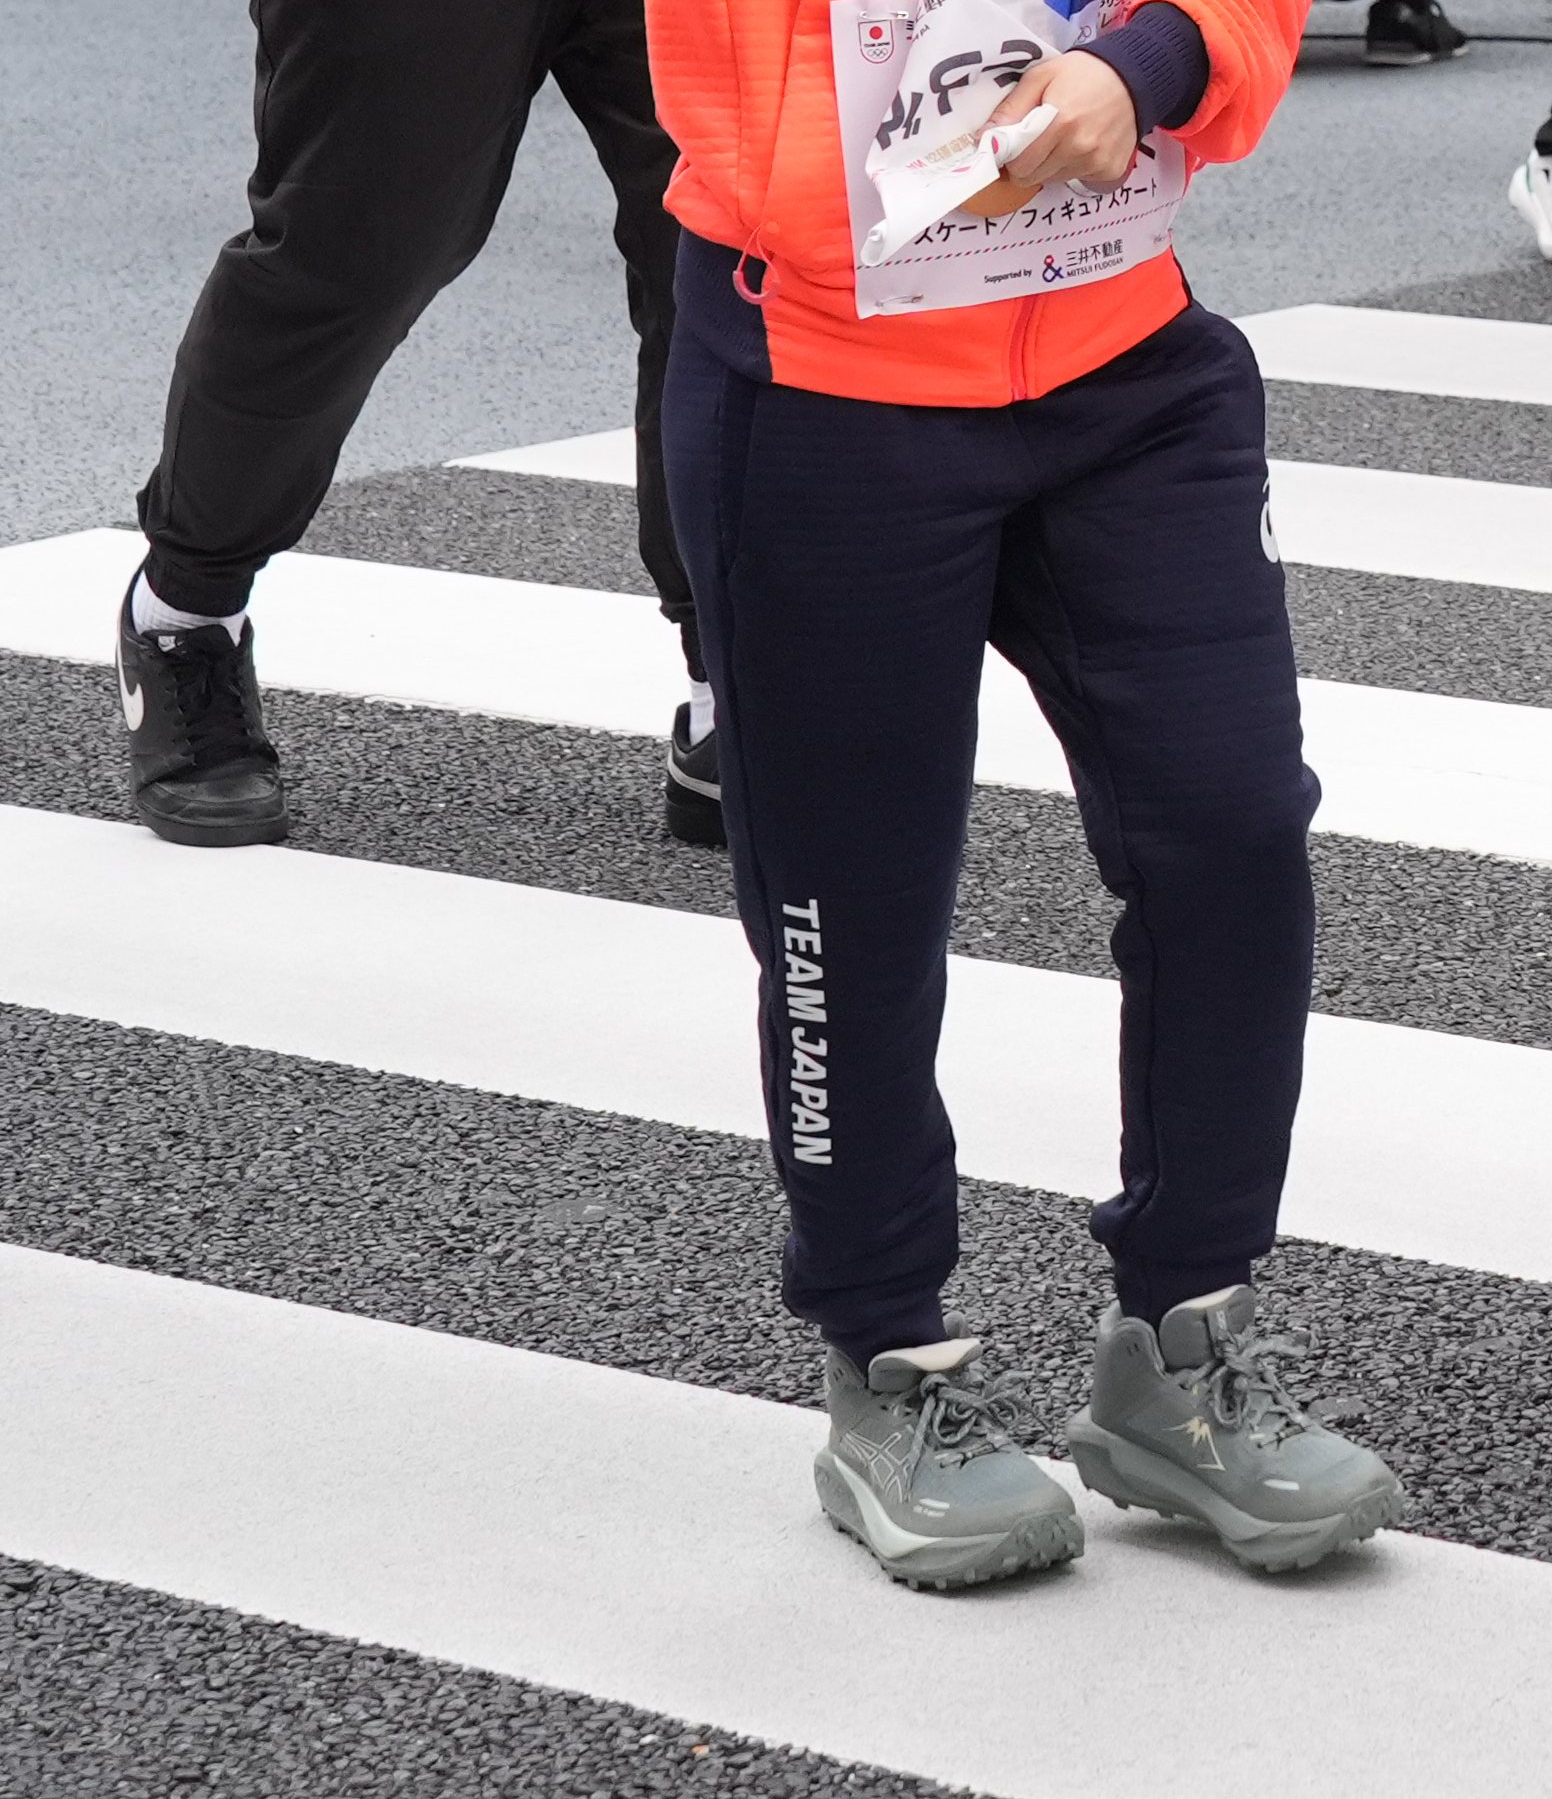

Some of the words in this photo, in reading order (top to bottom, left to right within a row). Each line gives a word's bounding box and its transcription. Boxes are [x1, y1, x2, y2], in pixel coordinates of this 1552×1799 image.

[1066, 239, 1123, 267] 三井不動産
[984, 269, 1022, 284] Supported
[1023, 268, 1033, 278] by
[1066, 265, 1093, 278] MITSUI
[782, 898, 828, 1024] TEAM
[790, 1026, 833, 1166] JAPAN
